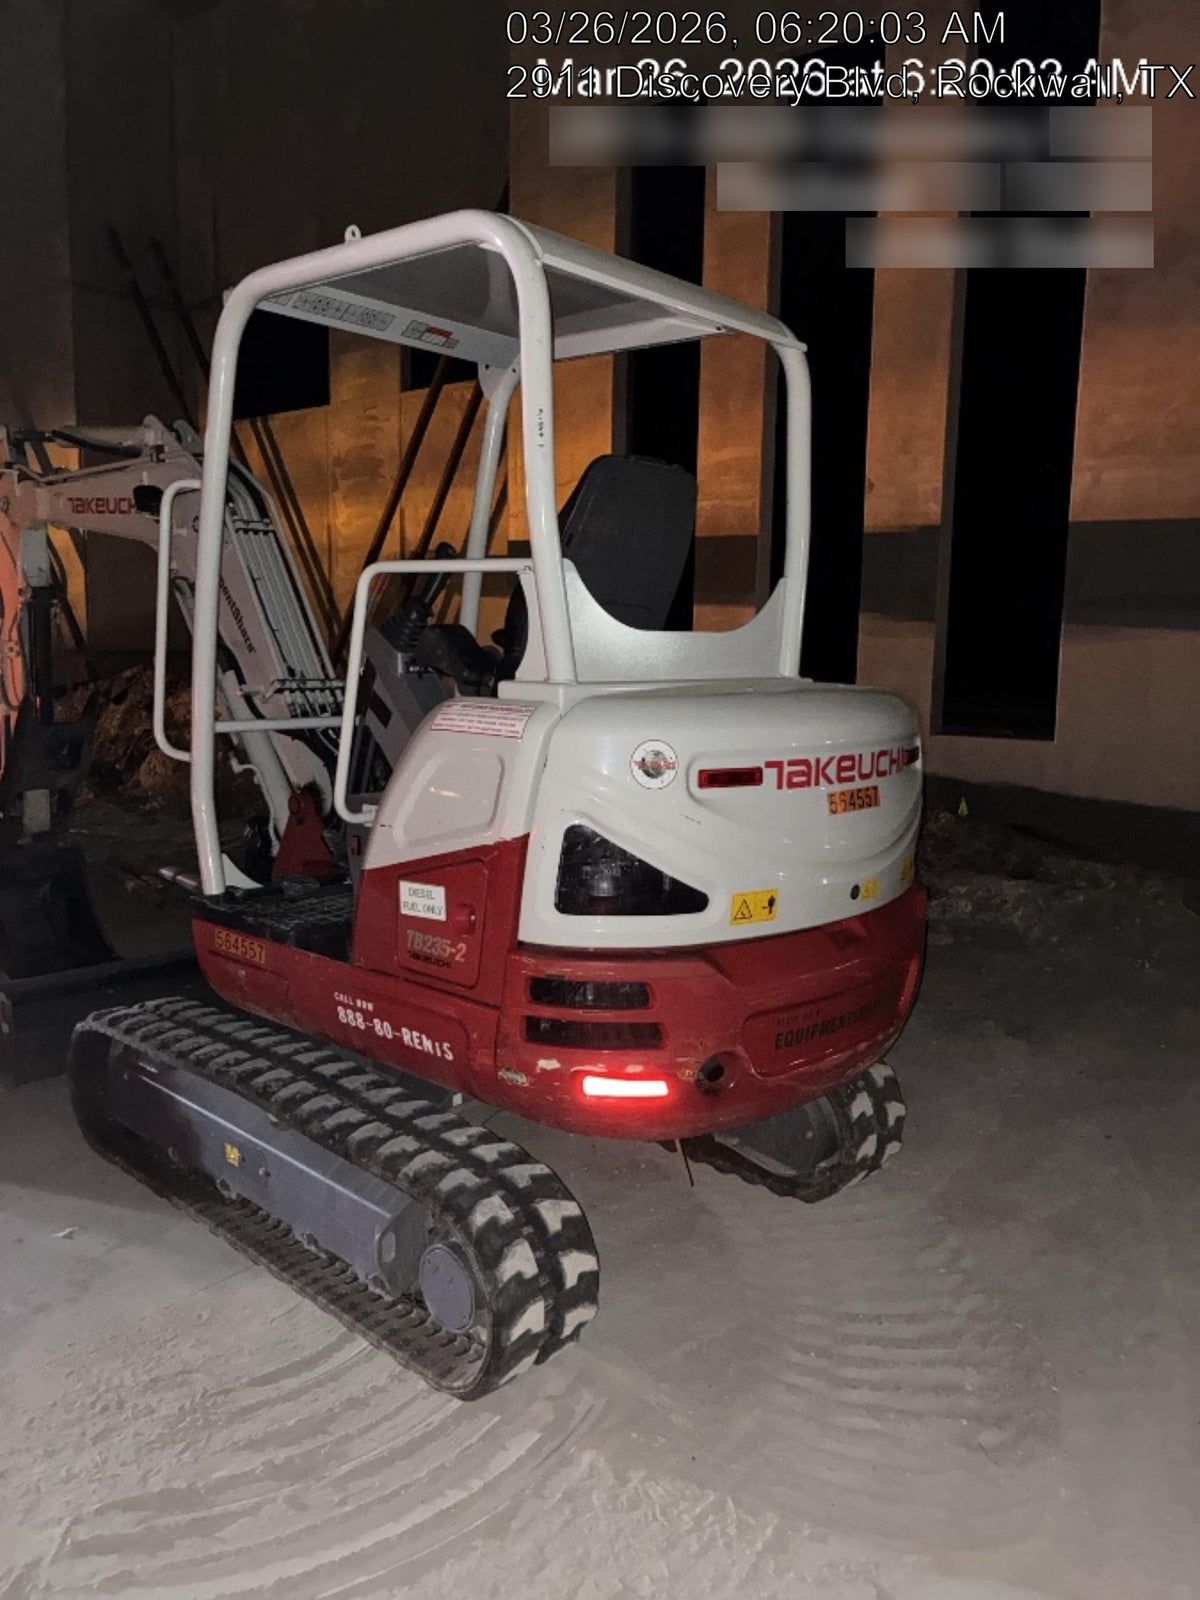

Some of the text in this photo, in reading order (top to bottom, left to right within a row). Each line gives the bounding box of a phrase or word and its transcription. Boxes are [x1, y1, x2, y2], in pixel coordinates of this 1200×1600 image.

[66, 496, 142, 515] TAKEUCH
[828, 786, 880, 815] 564557
[215, 929, 265, 963] 564557
[406, 929, 467, 962] TB235-2
